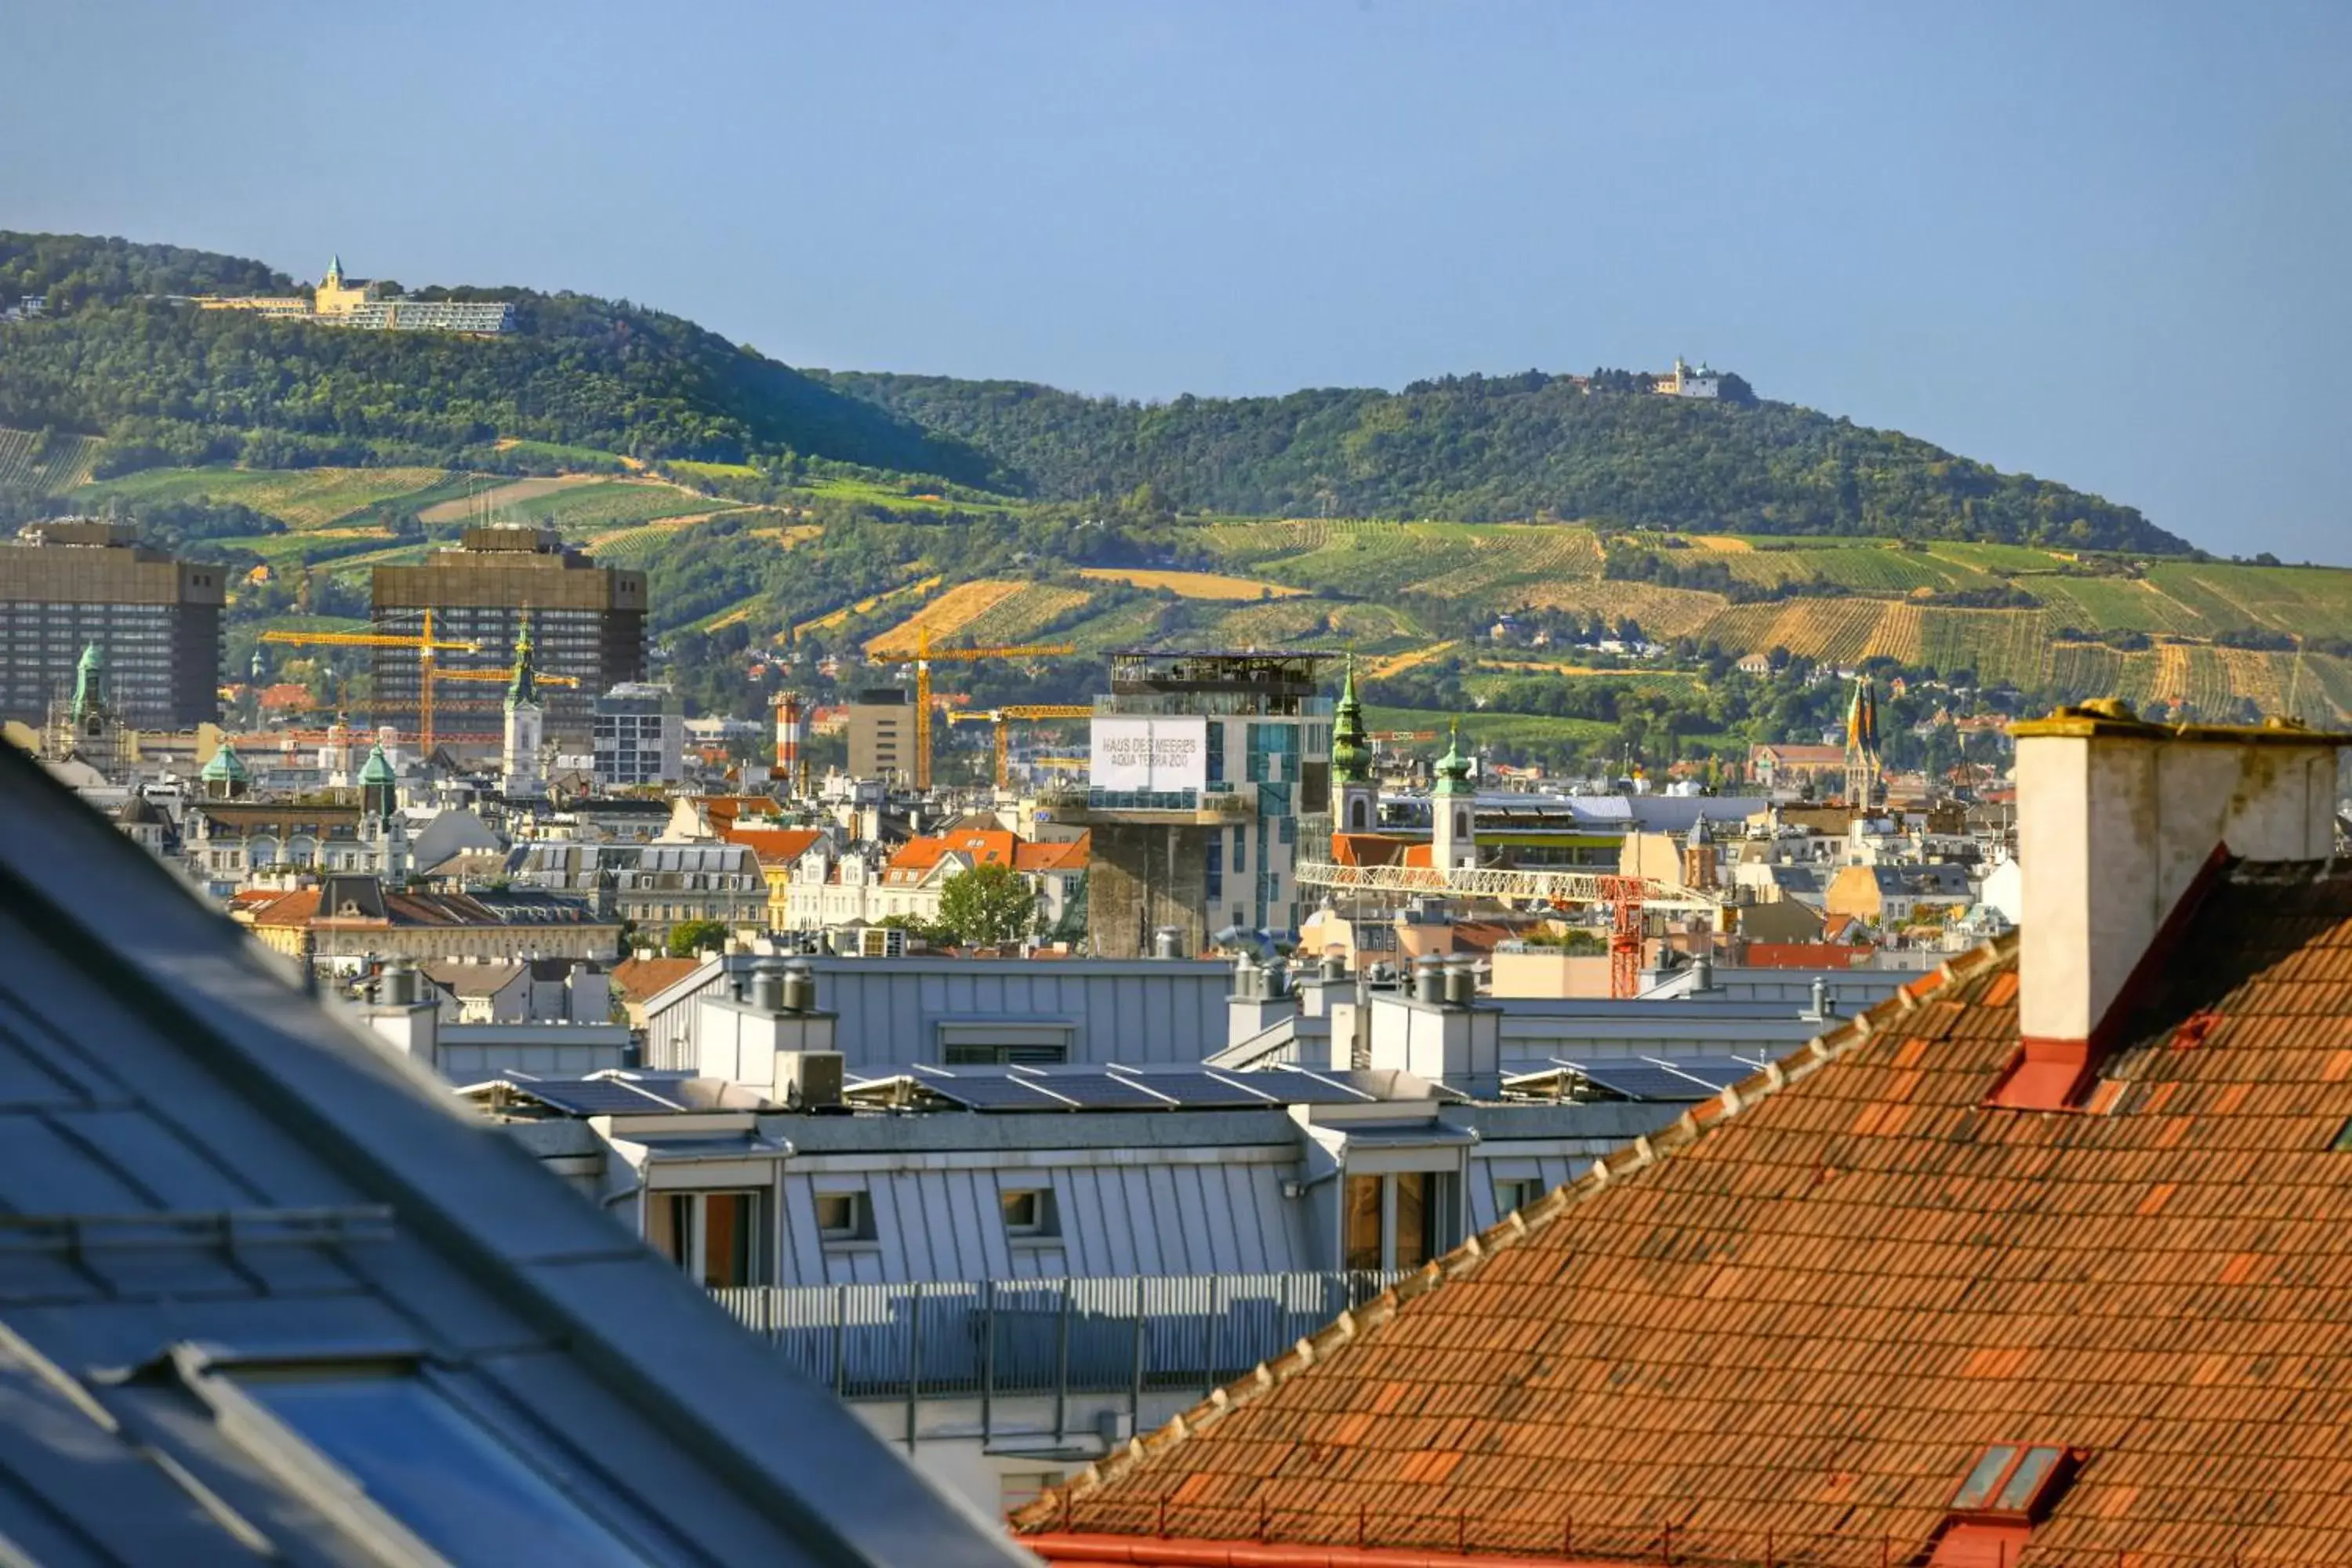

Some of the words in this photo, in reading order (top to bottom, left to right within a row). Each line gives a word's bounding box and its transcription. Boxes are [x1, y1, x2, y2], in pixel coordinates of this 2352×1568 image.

[1102, 739, 1130, 753] HAUS
[1133, 739, 1152, 753] DES
[1156, 739, 1196, 753] MEERES
[1111, 754, 1135, 767] AQUA
[1138, 754, 1167, 767] TERRA
[1169, 754, 1188, 767] ZOO
